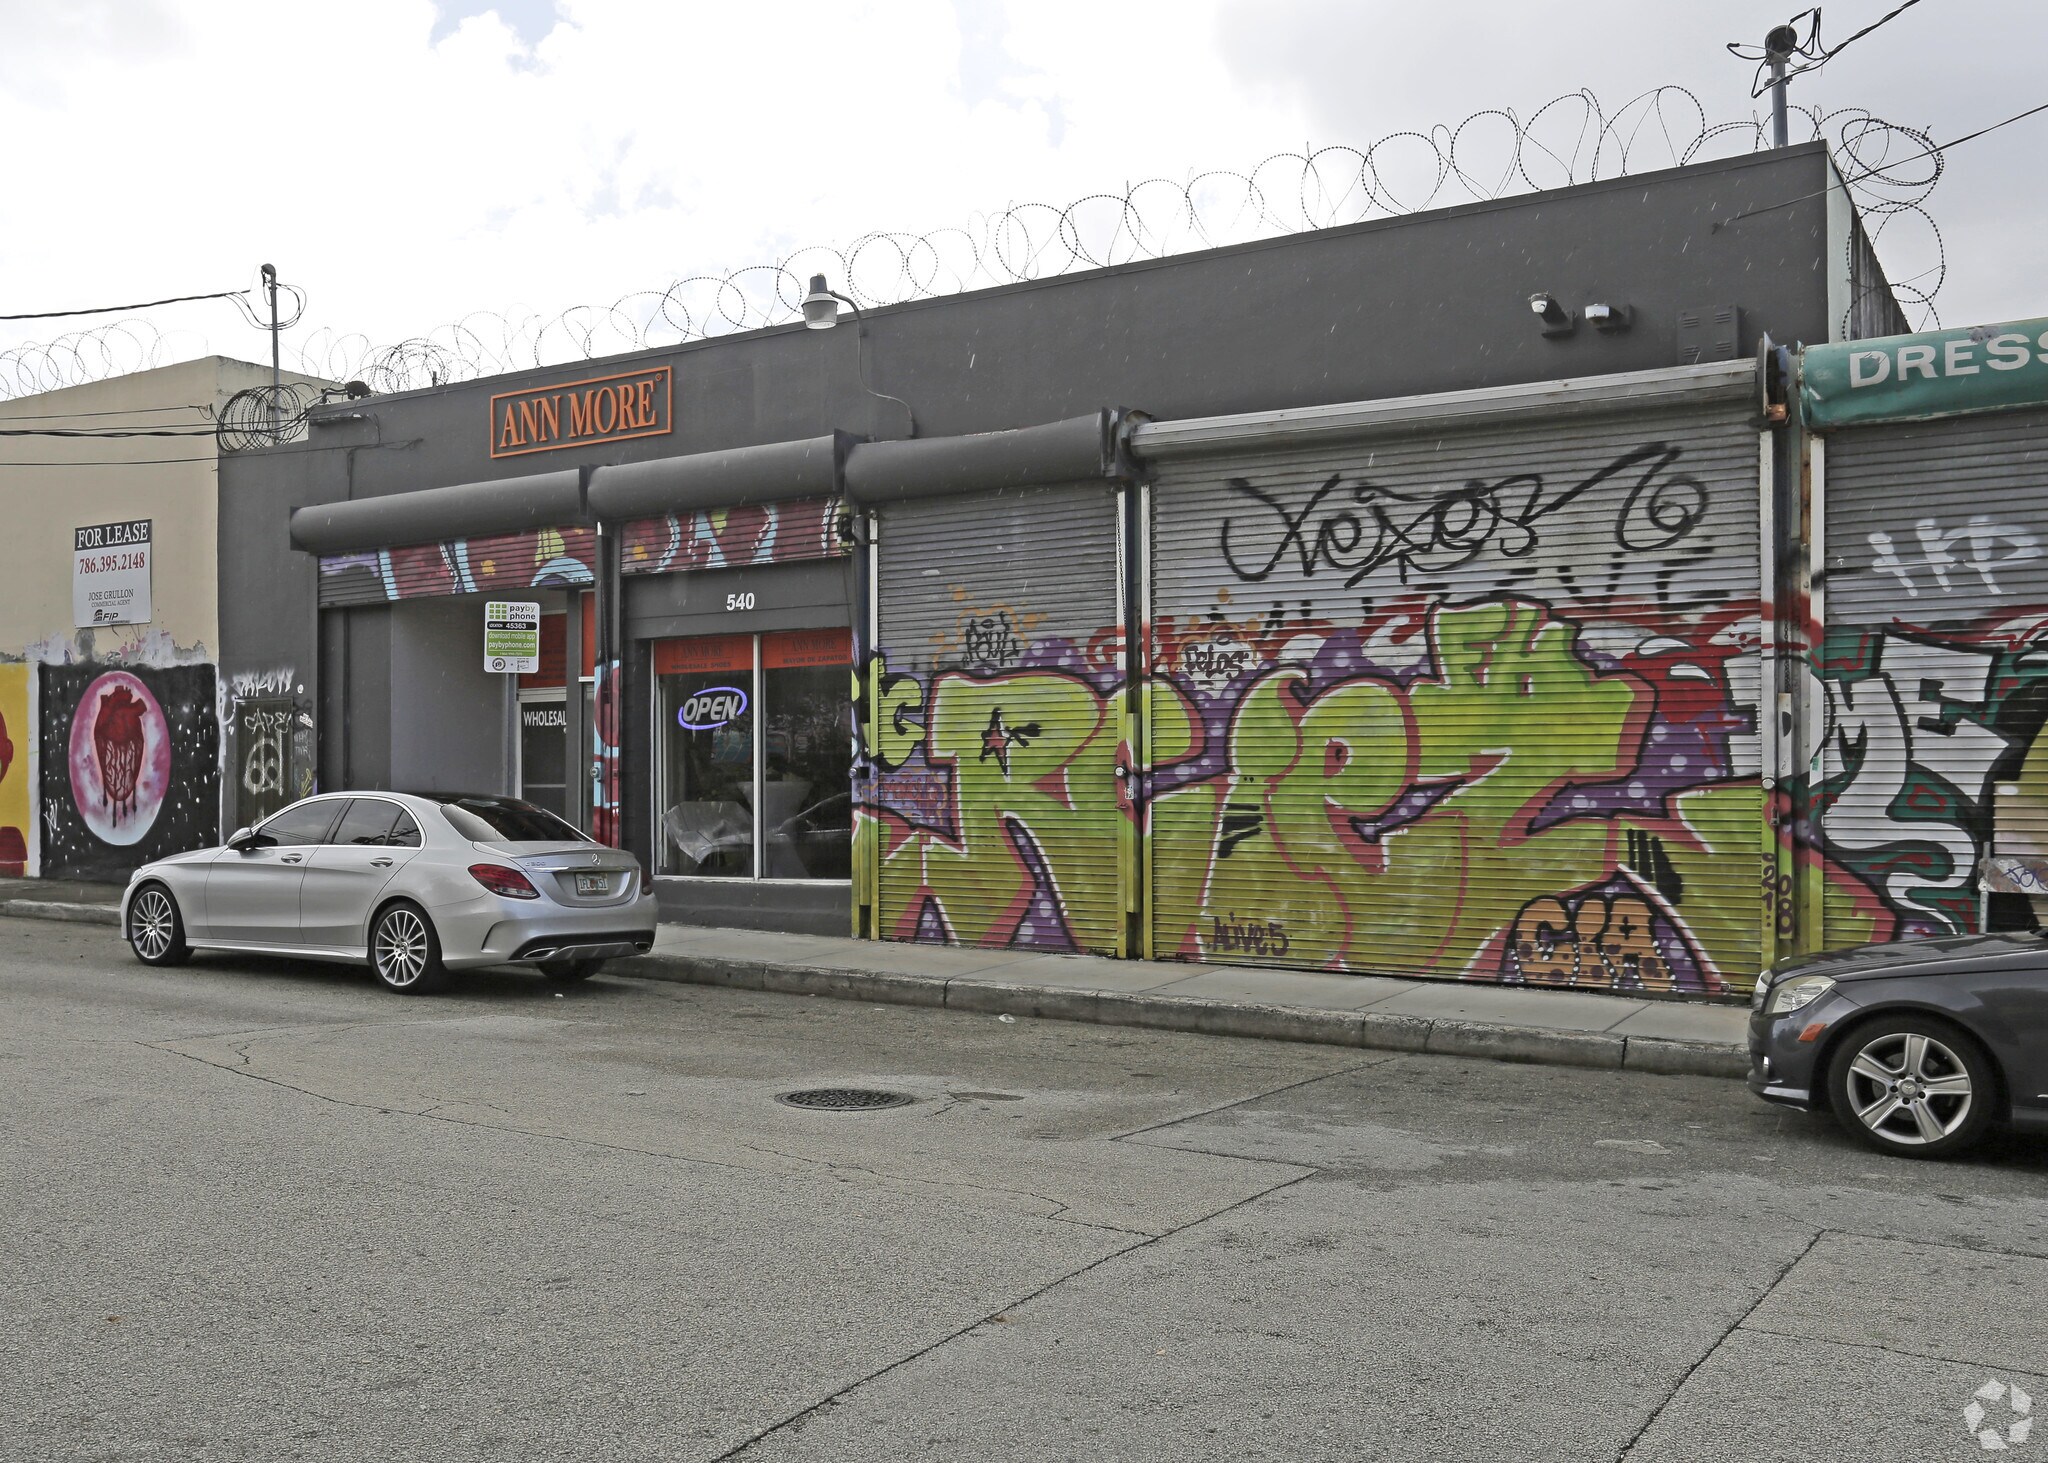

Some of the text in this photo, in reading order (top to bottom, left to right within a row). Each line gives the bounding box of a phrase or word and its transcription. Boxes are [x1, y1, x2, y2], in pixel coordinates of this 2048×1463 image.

[1850, 333, 2048, 388] DRES
[499, 380, 657, 448] ANN MORE
[77, 522, 148, 548] FOR LEASE
[79, 552, 145, 575] 786.395.2148
[88, 588, 134, 601] JOSE GRULLON
[726, 592, 755, 611] 540
[102, 612, 119, 621] FIP
[509, 604, 536, 613] payby
[488, 641, 536, 649] paybyphone.com
[527, 633, 536, 641] app
[682, 695, 740, 722] OPEN
